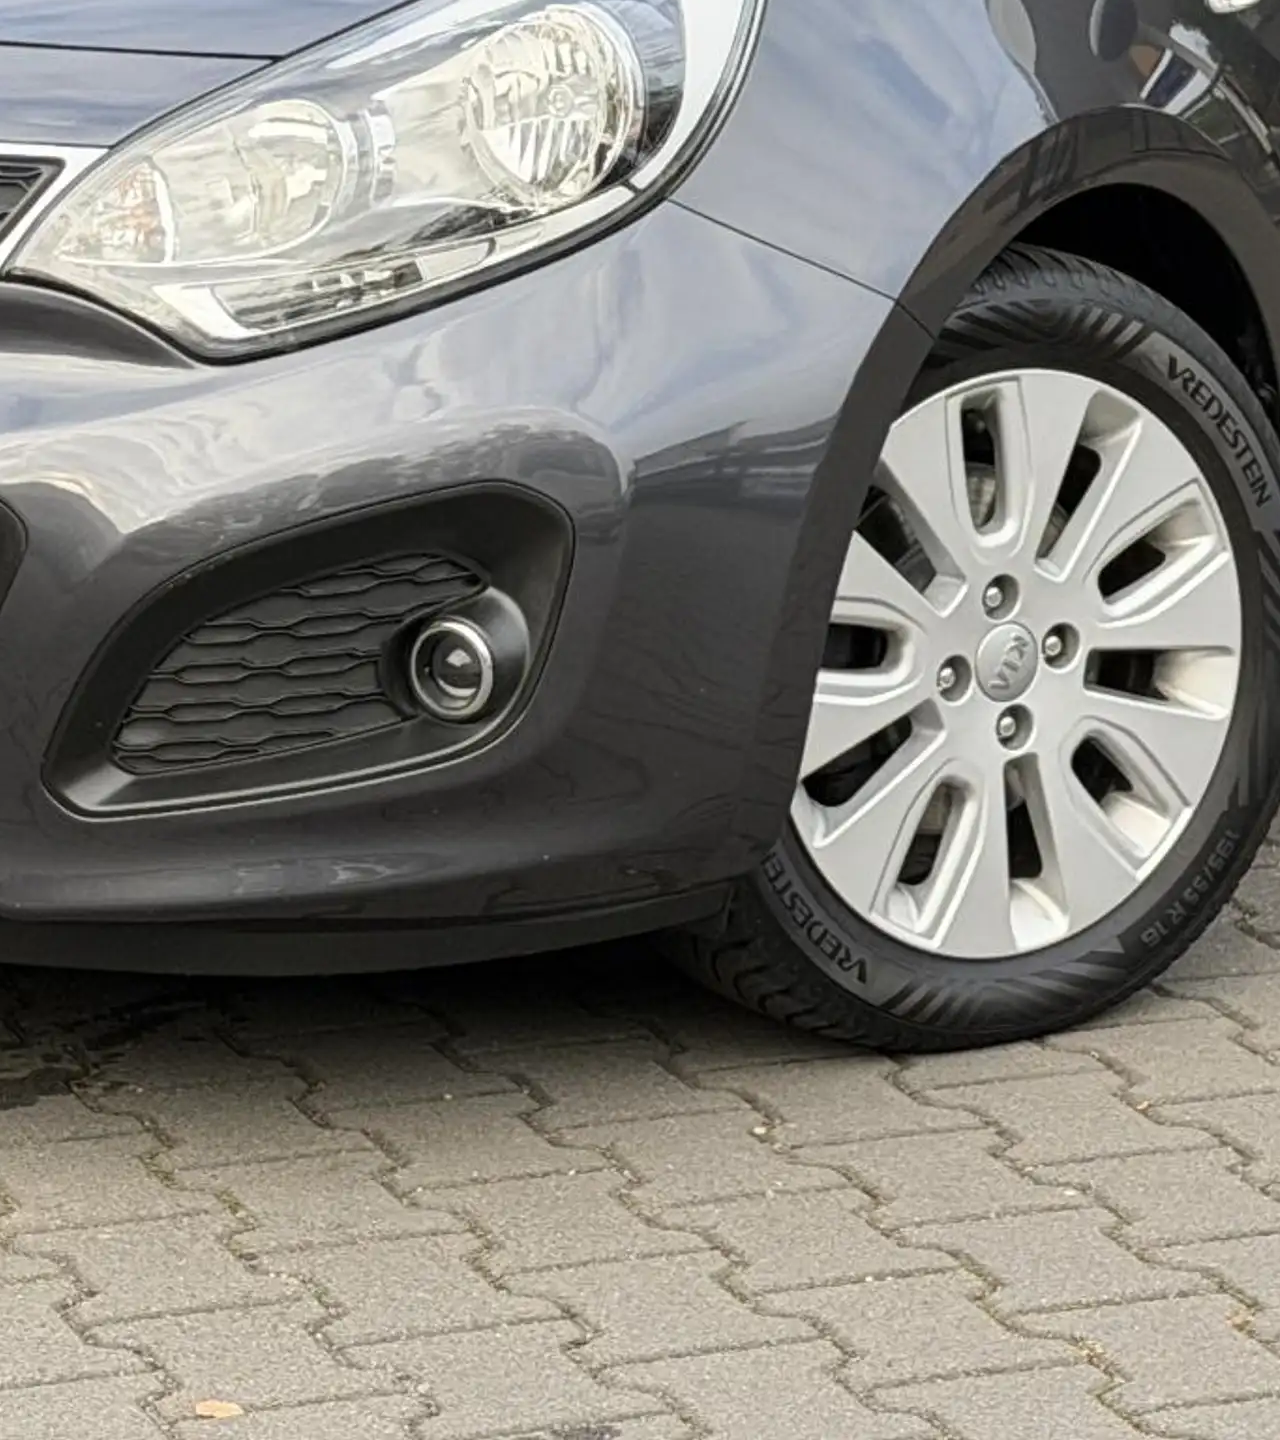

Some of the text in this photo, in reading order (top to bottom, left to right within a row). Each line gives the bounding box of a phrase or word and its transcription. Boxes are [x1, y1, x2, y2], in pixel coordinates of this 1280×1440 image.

[1166, 353, 1272, 509] VREDESTEIN
[988, 633, 1029, 690] KIA
[760, 850, 869, 986] VREDESTEI
